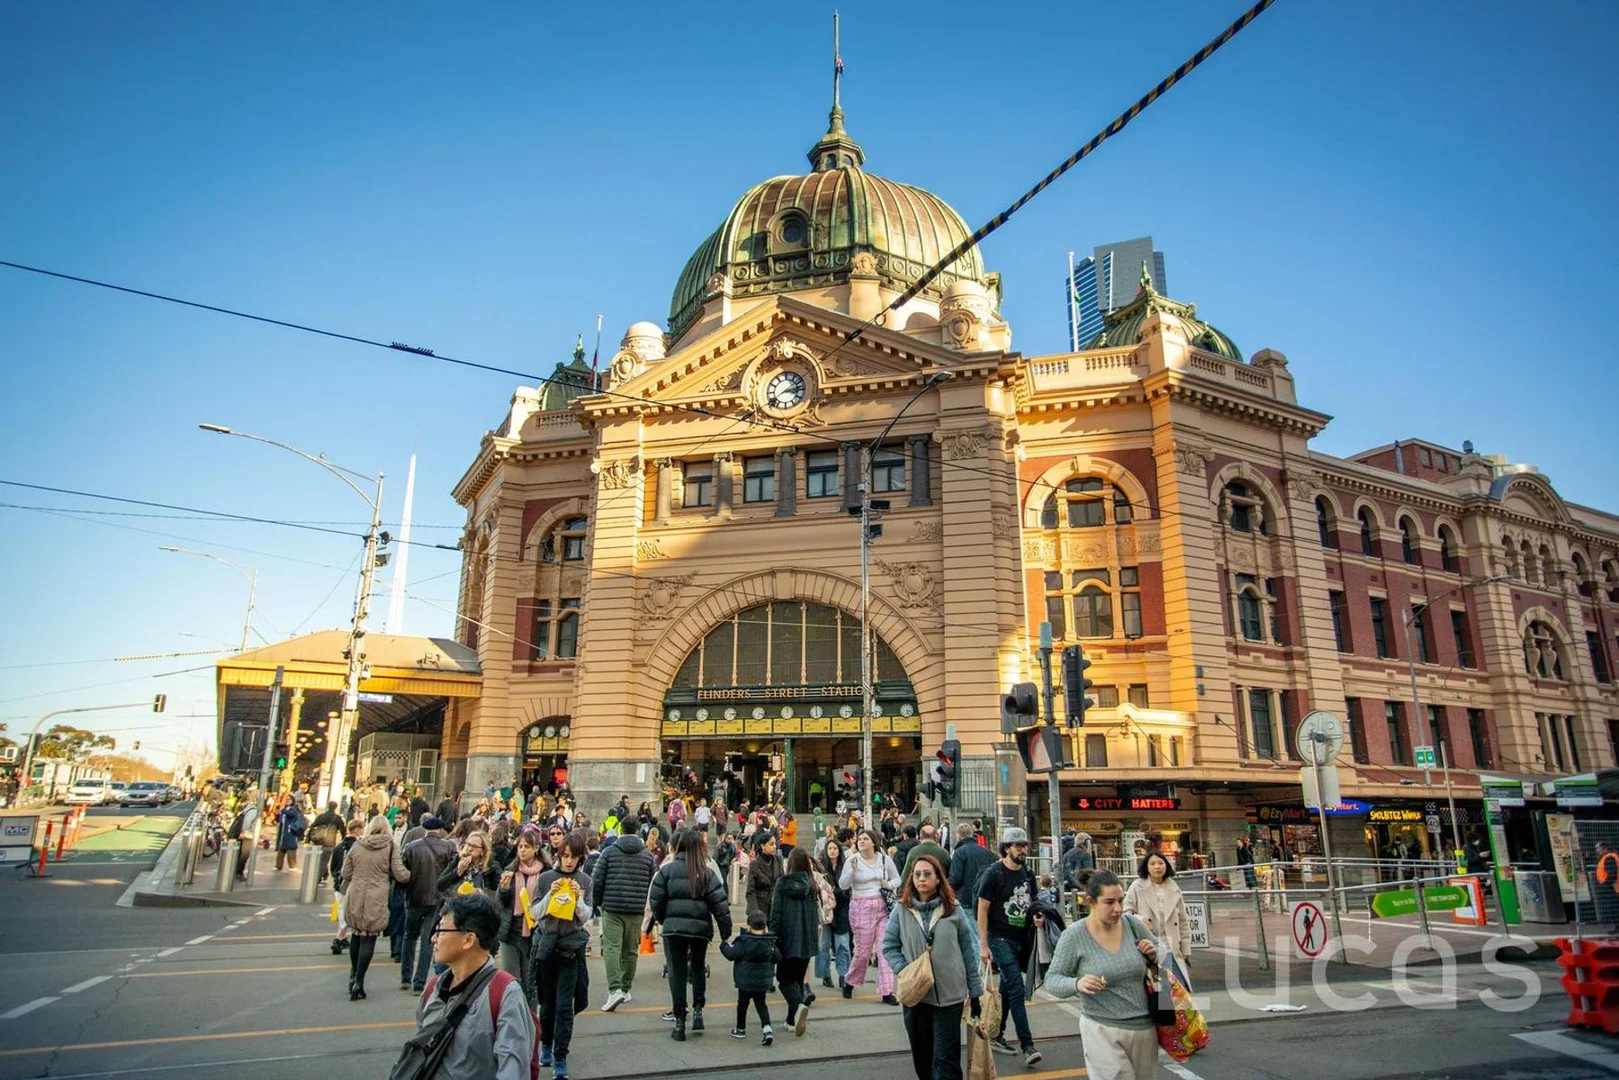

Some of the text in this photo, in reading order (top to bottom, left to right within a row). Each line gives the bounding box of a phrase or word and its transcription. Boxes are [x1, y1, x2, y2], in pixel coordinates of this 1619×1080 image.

[697, 689, 751, 699] FLINDERS
[765, 688, 807, 698] STREET
[1094, 799, 1175, 809] CITY HATTERS
